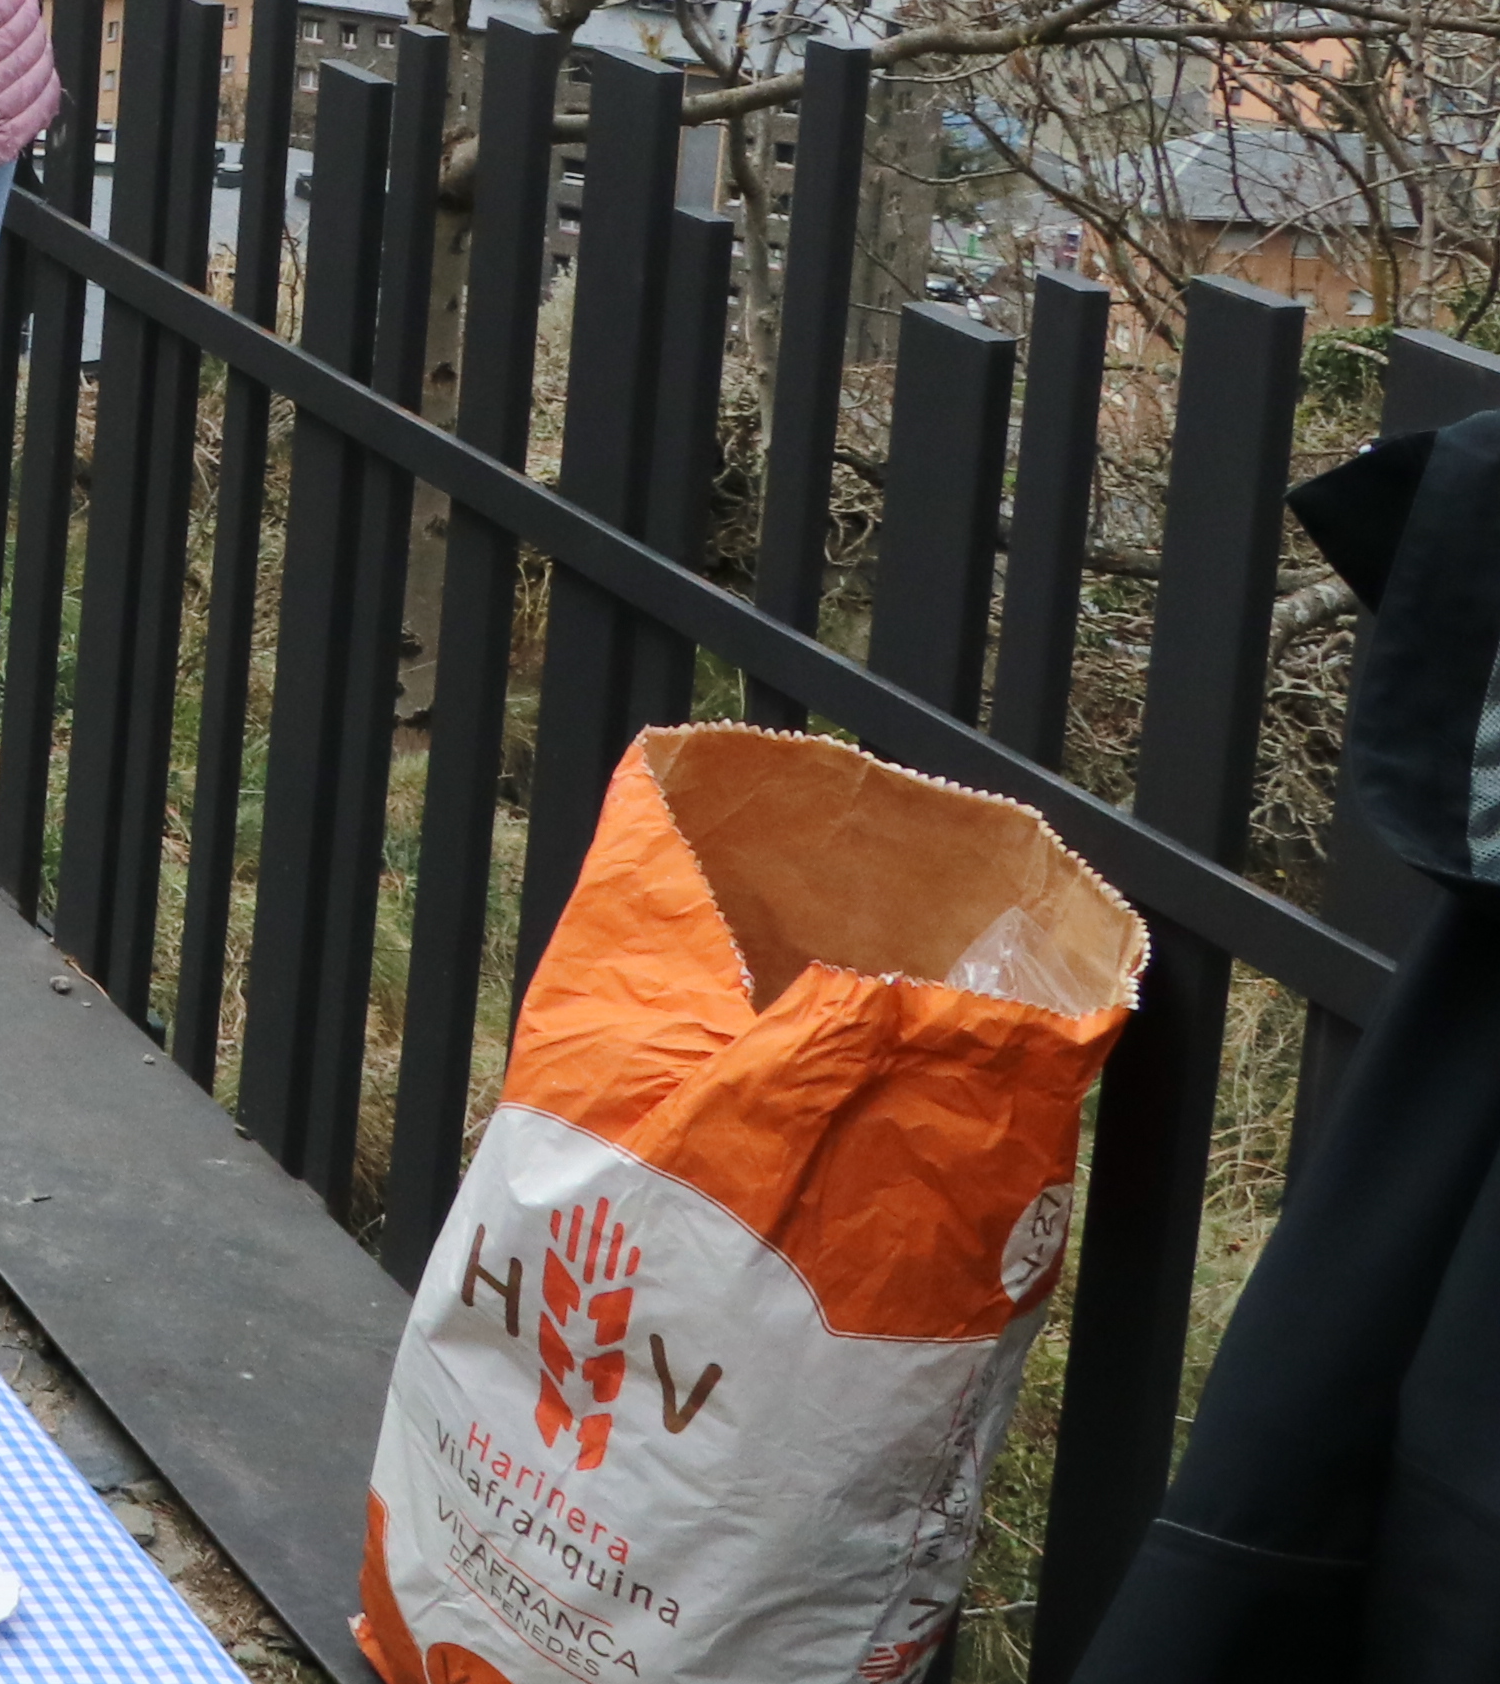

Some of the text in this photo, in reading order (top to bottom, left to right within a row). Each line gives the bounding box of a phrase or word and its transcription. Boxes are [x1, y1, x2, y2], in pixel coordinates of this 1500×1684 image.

[460, 1222, 723, 1435] H V
[435, 1418, 681, 1628] Vilafranquina
[449, 1545, 488, 1592] DEL
[466, 1421, 630, 1566] Harinera
[437, 1494, 641, 1678] VILAFRANCA
